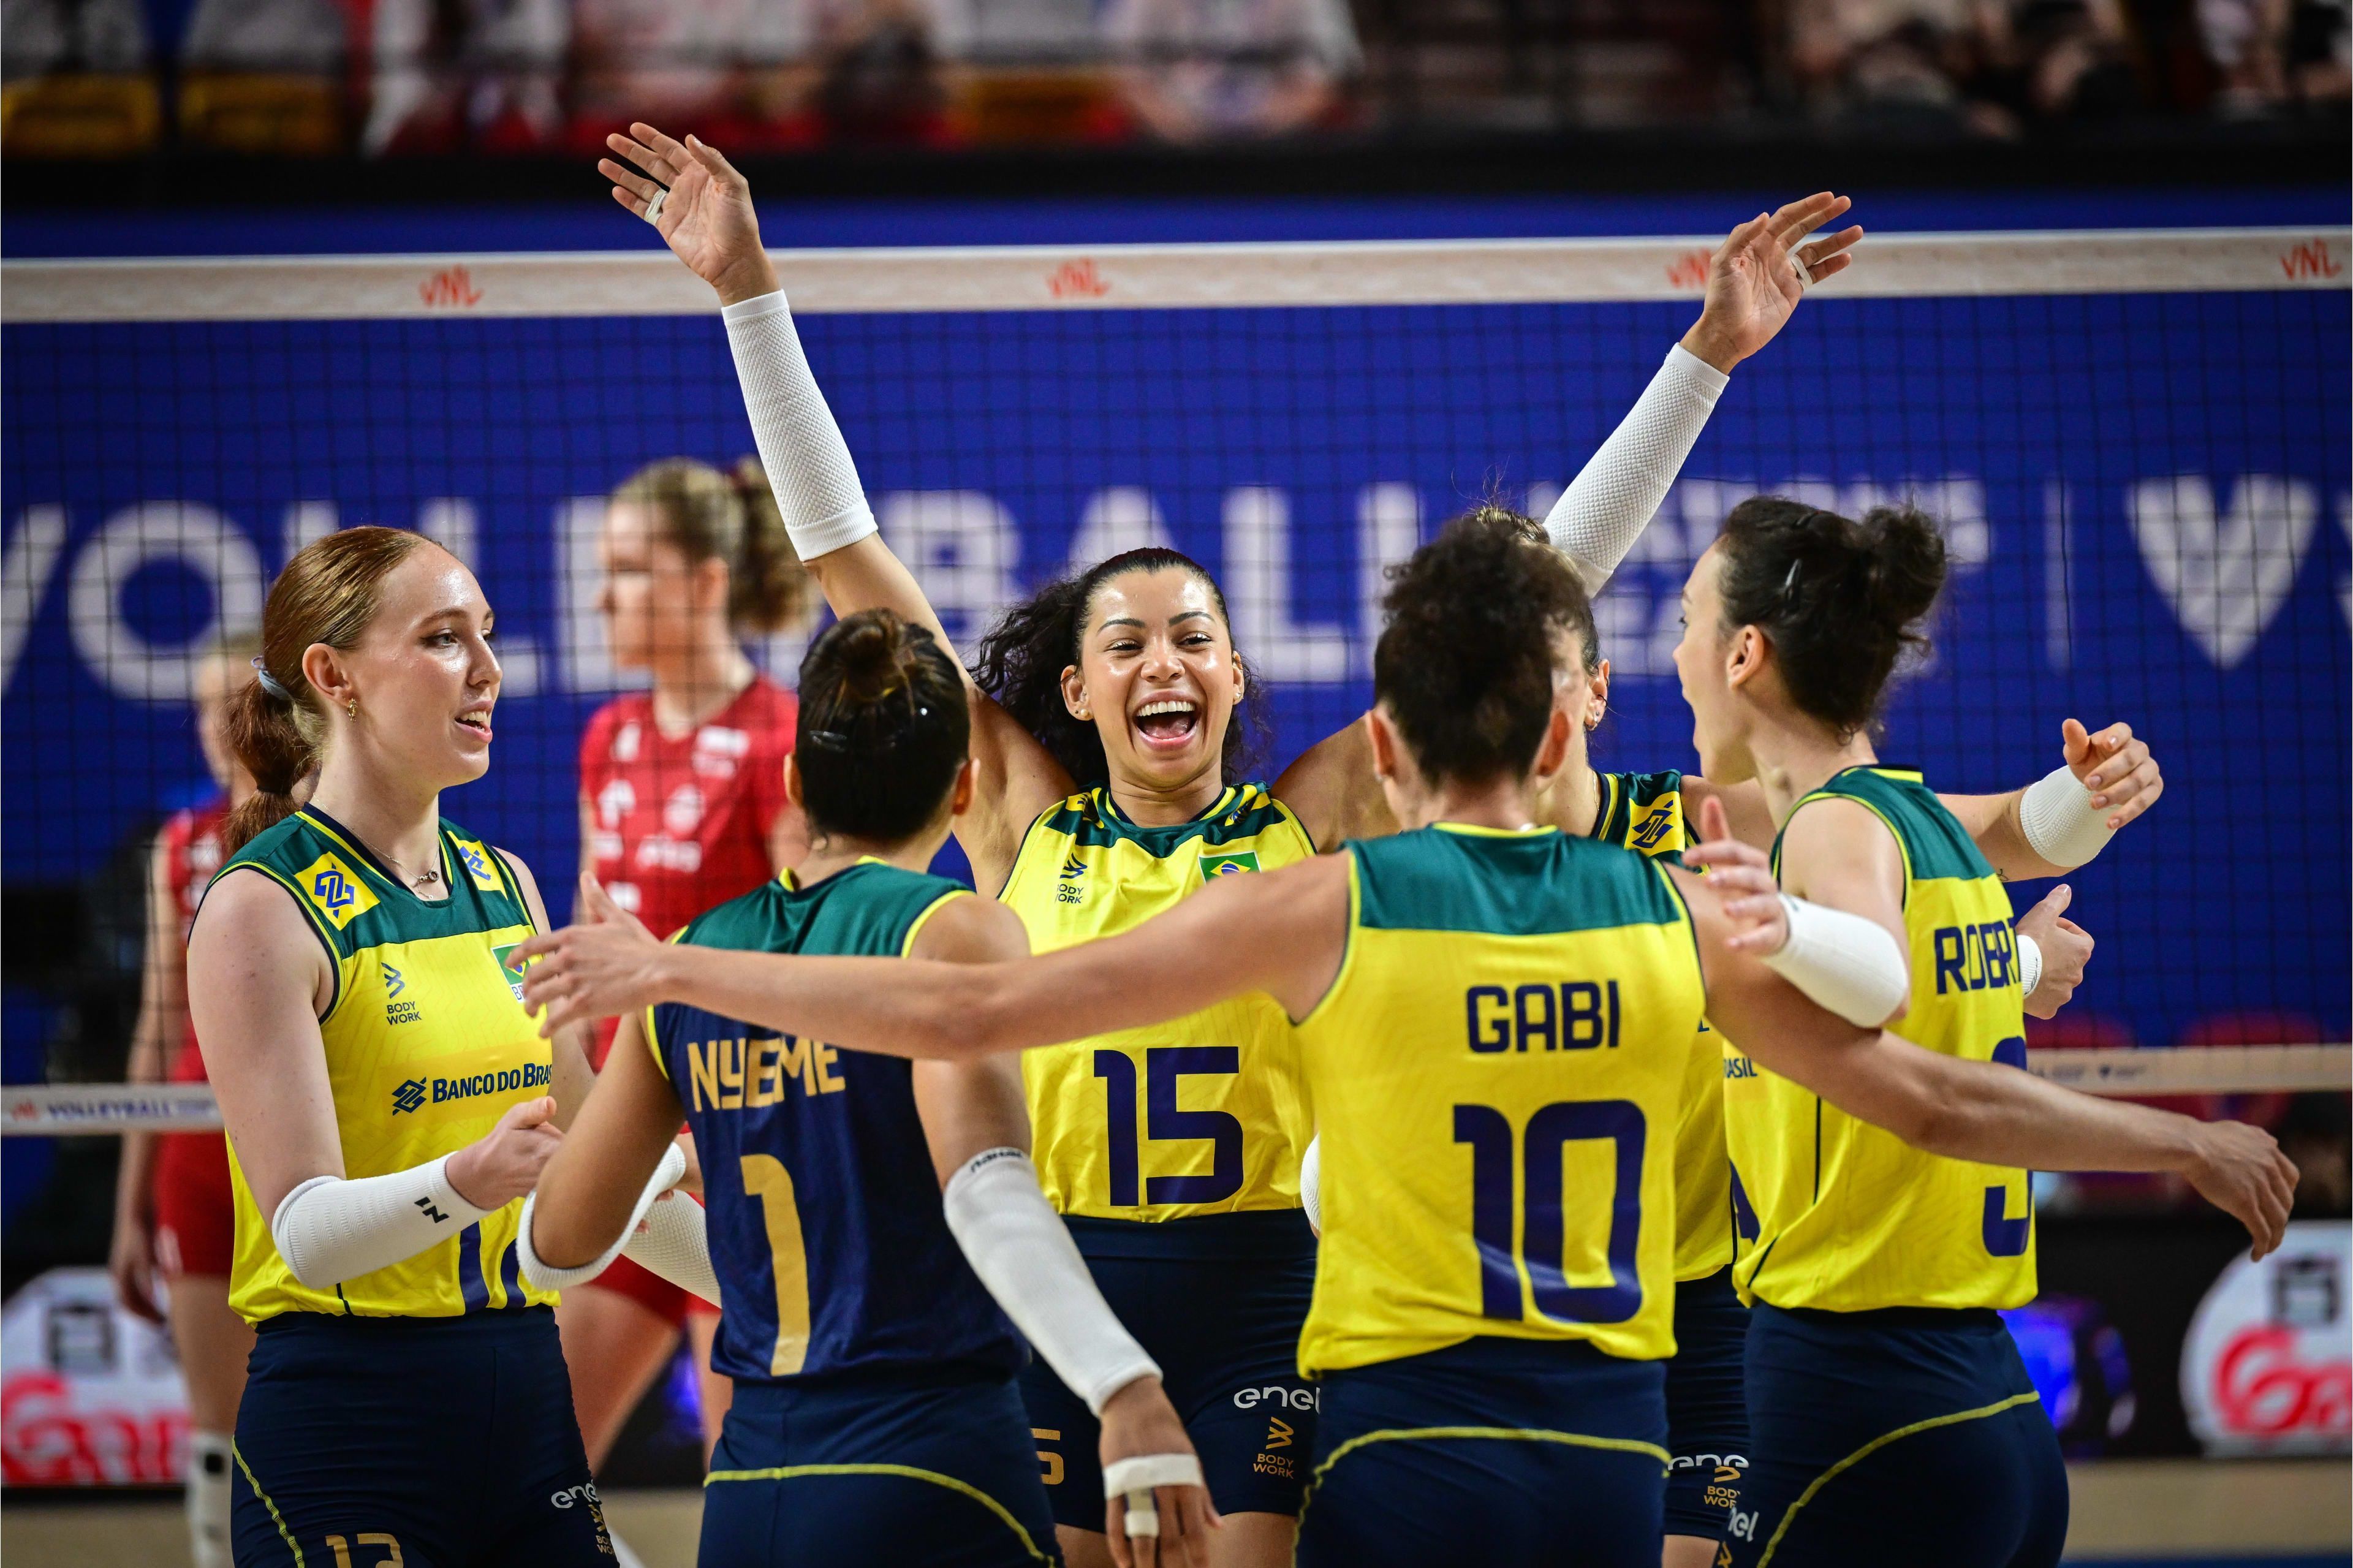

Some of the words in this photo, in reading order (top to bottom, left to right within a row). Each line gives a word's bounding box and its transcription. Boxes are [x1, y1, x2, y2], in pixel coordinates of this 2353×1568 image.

[1055, 893, 1083, 904] ORK
[1057, 884, 1084, 895] ODY
[1934, 917, 2021, 994] ROBERT
[387, 1001, 416, 1014] BODY
[387, 1011, 422, 1025] WORK
[1466, 980, 1621, 1053] GABI
[687, 1037, 846, 1113] NYEME
[1724, 1056, 1757, 1078] ASIL
[433, 1074, 494, 1104] BANCO
[498, 1069, 521, 1092] DO
[1094, 1046, 1244, 1206] 15
[1453, 1099, 1646, 1324] 10
[740, 1154, 811, 1377] 1
[1233, 1386, 1320, 1415] enel
[1253, 1463, 1294, 1479] WORK
[1257, 1453, 1294, 1468] BODY
[1707, 1485, 1741, 1499] BOD
